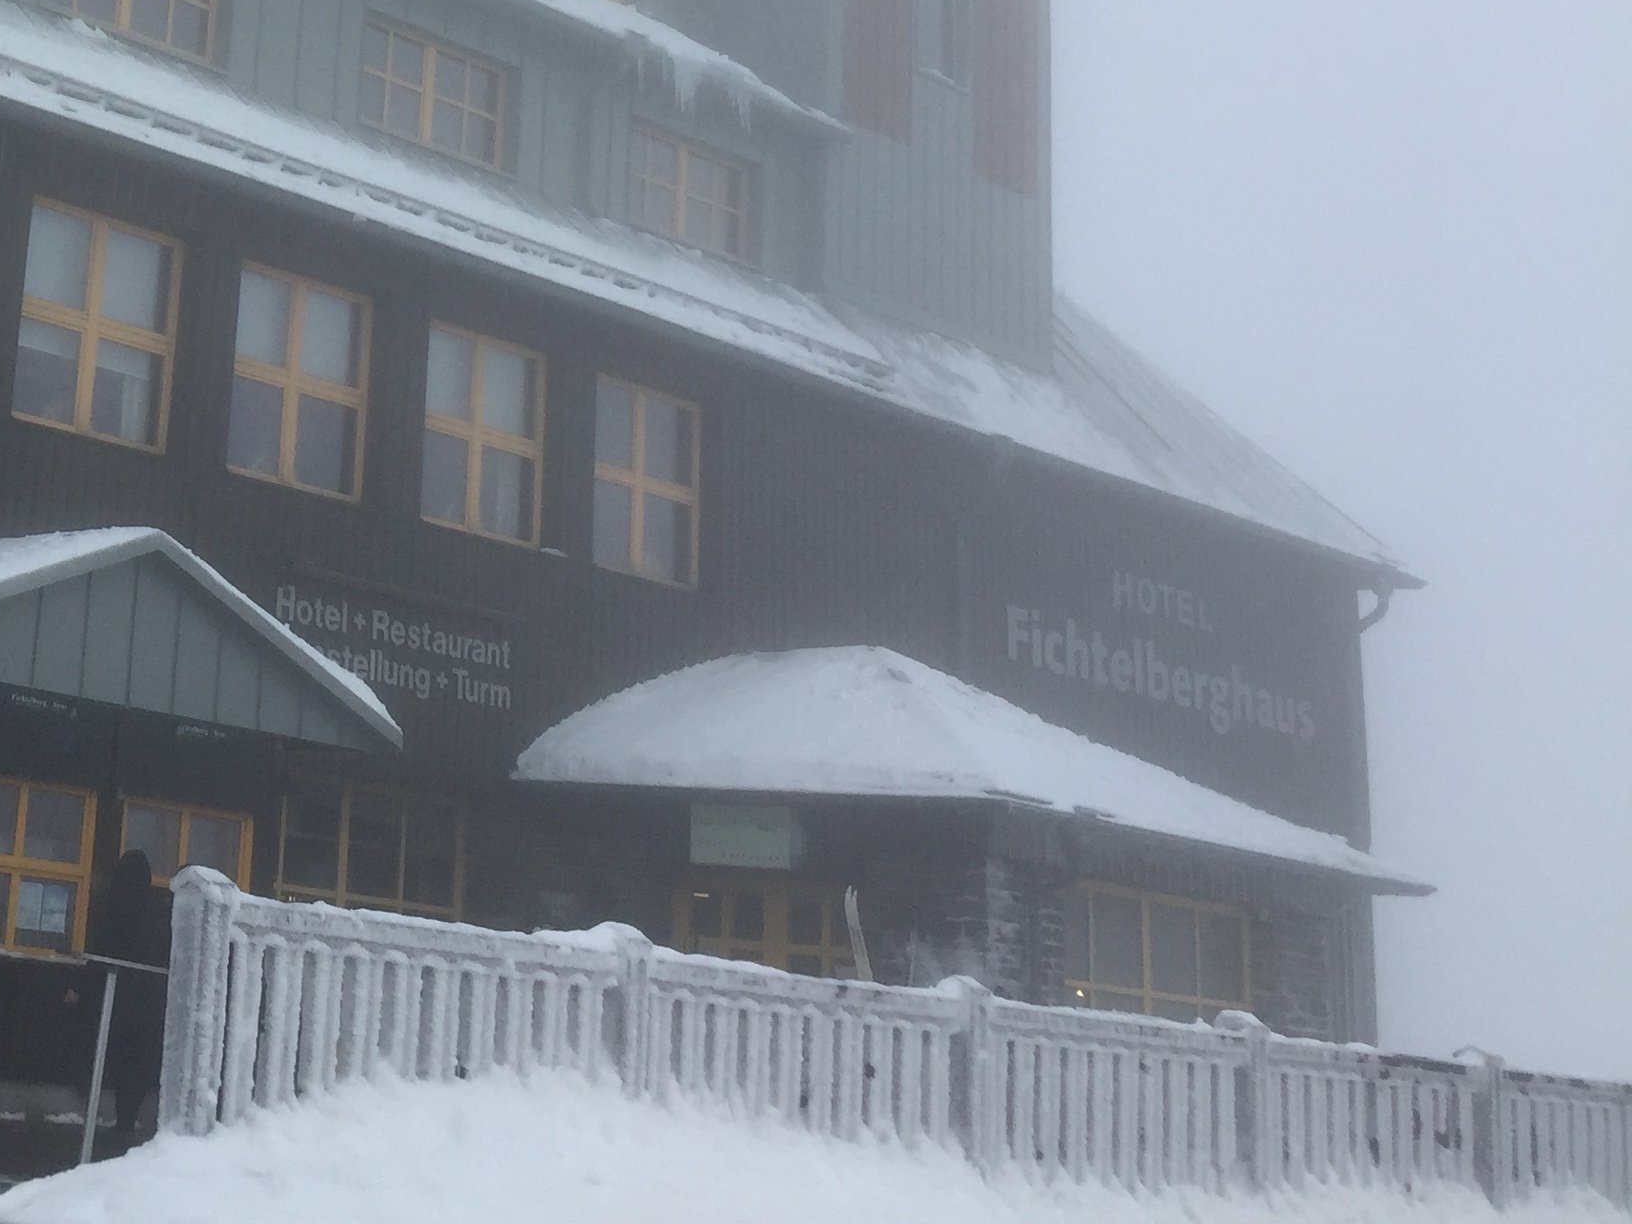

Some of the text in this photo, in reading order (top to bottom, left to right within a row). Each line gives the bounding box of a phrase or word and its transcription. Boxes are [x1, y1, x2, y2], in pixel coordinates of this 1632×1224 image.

[276, 584, 348, 633] Hotel
[372, 609, 511, 670] Restaurant
[1112, 572, 1214, 633] HOTEL
[452, 667, 512, 710] Turm
[1005, 605, 1315, 739] Fichtelberghaus
